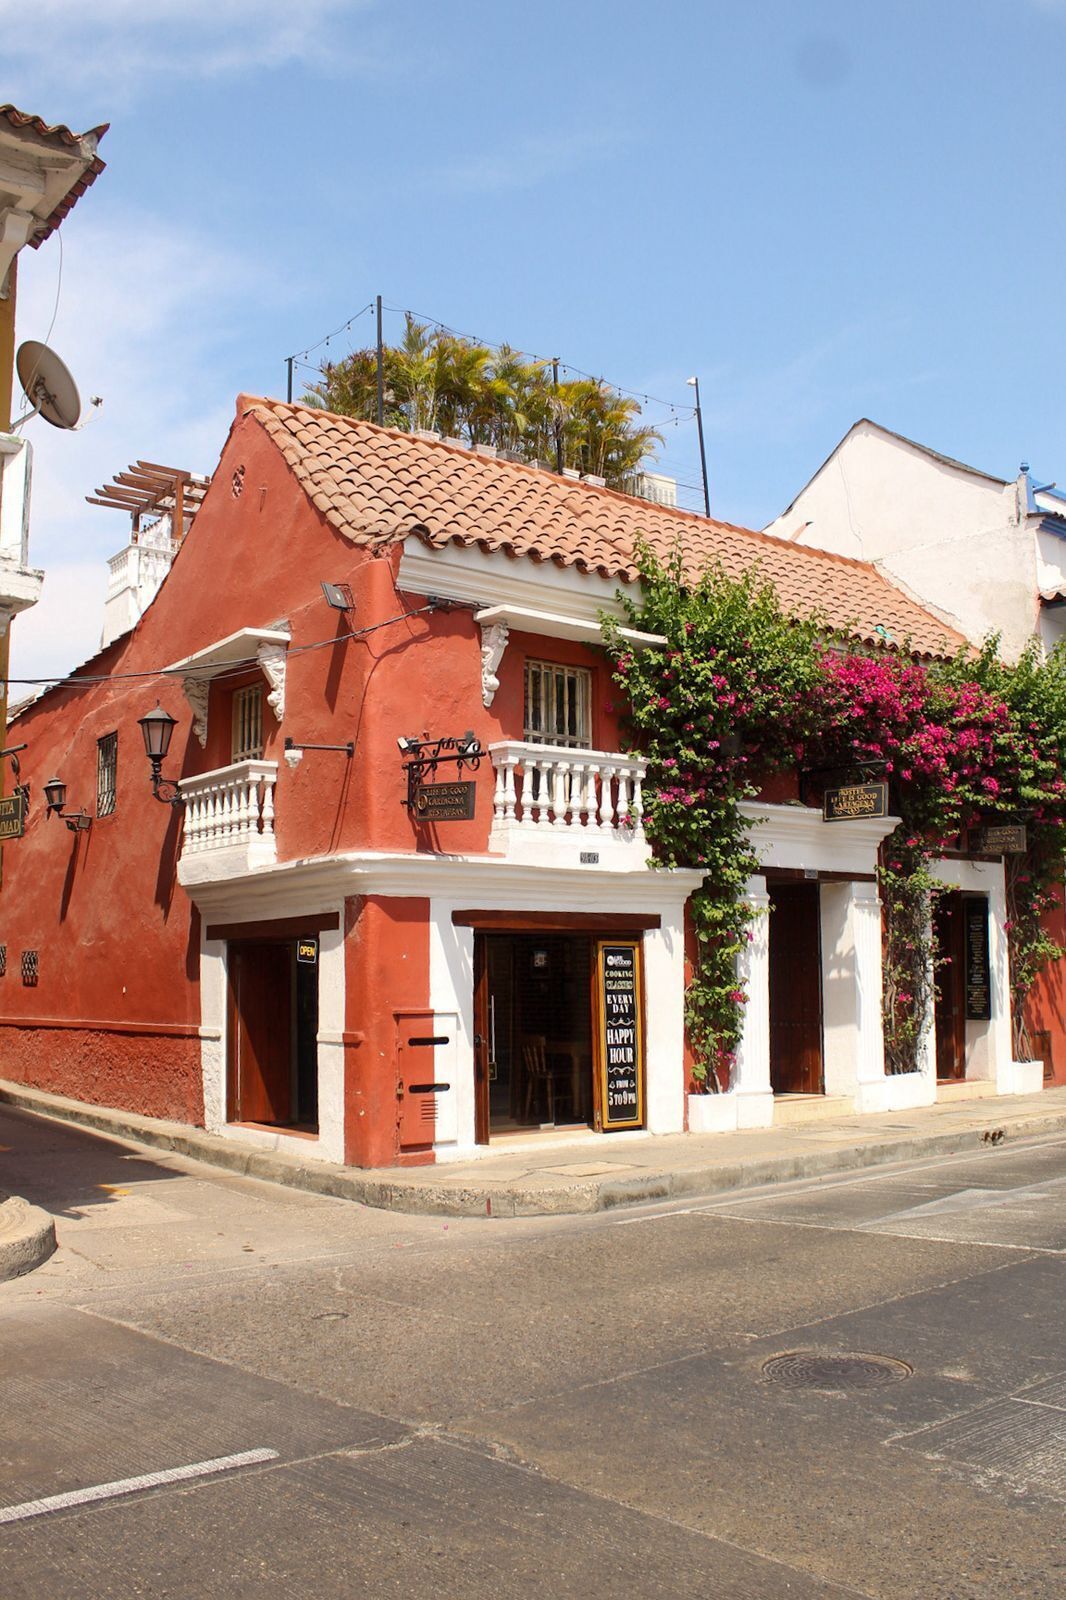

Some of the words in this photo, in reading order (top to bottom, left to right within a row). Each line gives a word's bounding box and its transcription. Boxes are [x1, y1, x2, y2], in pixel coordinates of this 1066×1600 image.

[300, 946, 315, 956] OPEN
[605, 970, 633, 978] COOKING
[606, 980, 633, 990] CLASSES
[607, 994, 633, 1004] EVERY
[612, 1004, 630, 1014] DAY
[607, 1028, 634, 1045] HAPPY
[610, 1048, 633, 1064] HOUR
[616, 1079, 629, 1089] FROM
[614, 1093, 623, 1105] TO
[623, 1090, 628, 1104] 9
